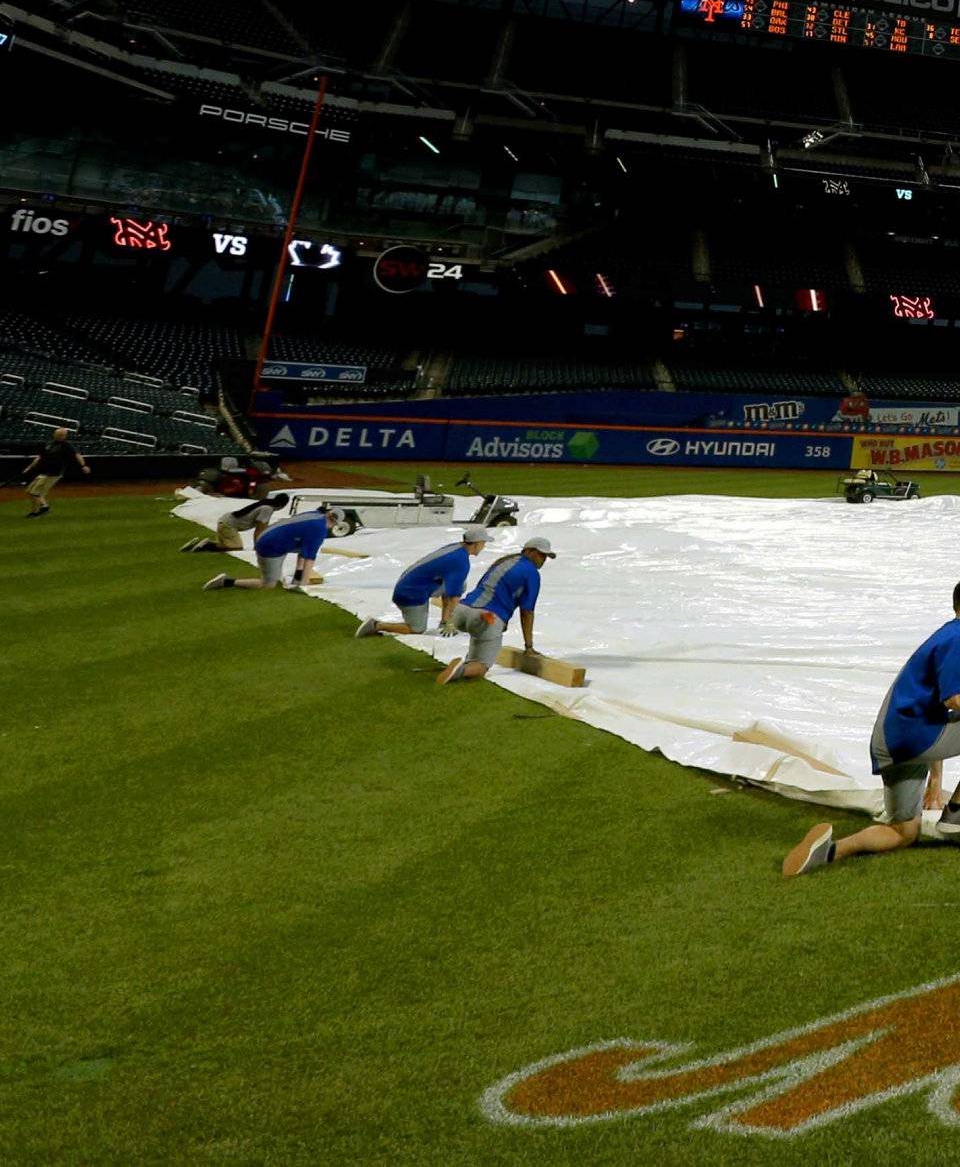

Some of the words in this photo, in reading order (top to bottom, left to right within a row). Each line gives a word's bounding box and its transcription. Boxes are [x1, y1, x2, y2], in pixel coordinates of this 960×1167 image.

[772, 0, 788, 9] PHI
[833, 9, 849, 18] CLE
[769, 16, 787, 25] OAK
[832, 18, 848, 27] DET
[768, 24, 786, 34] BOS
[831, 26, 847, 35] STL
[894, 27, 906, 35] KC
[199, 104, 352, 143] PORSCHE
[10, 209, 70, 237] fios
[426, 262, 464, 280] 24
[308, 427, 416, 448] DELTA
[466, 436, 564, 459] Advisors
[685, 440, 776, 457] HYUNDAI
[804, 445, 832, 458] 358
